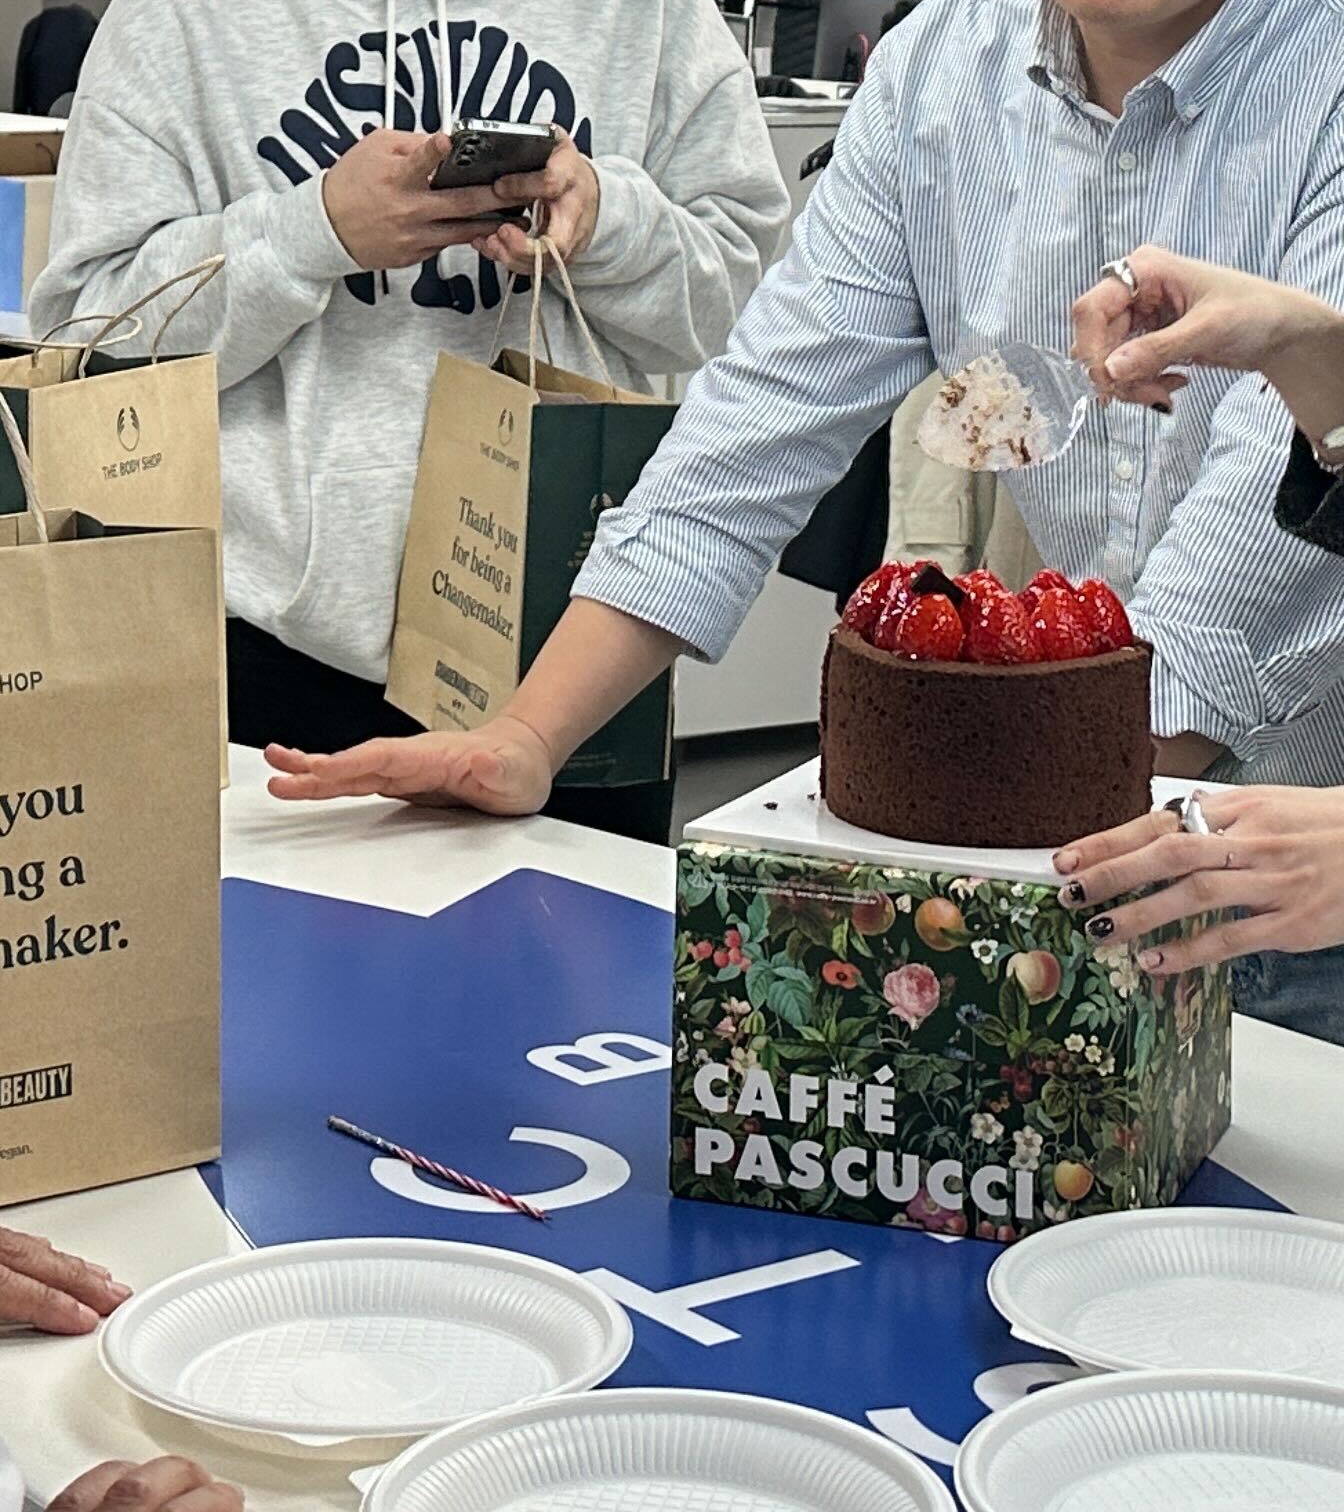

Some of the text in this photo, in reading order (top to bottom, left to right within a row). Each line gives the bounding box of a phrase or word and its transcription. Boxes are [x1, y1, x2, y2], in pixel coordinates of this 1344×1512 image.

[459, 496, 518, 554] Thank you
[451, 535, 512, 595] for being a
[432, 569, 514, 641] Changemaker.
[59, 855, 86, 887] a
[694, 1127, 1034, 1220] PASCUCCI
